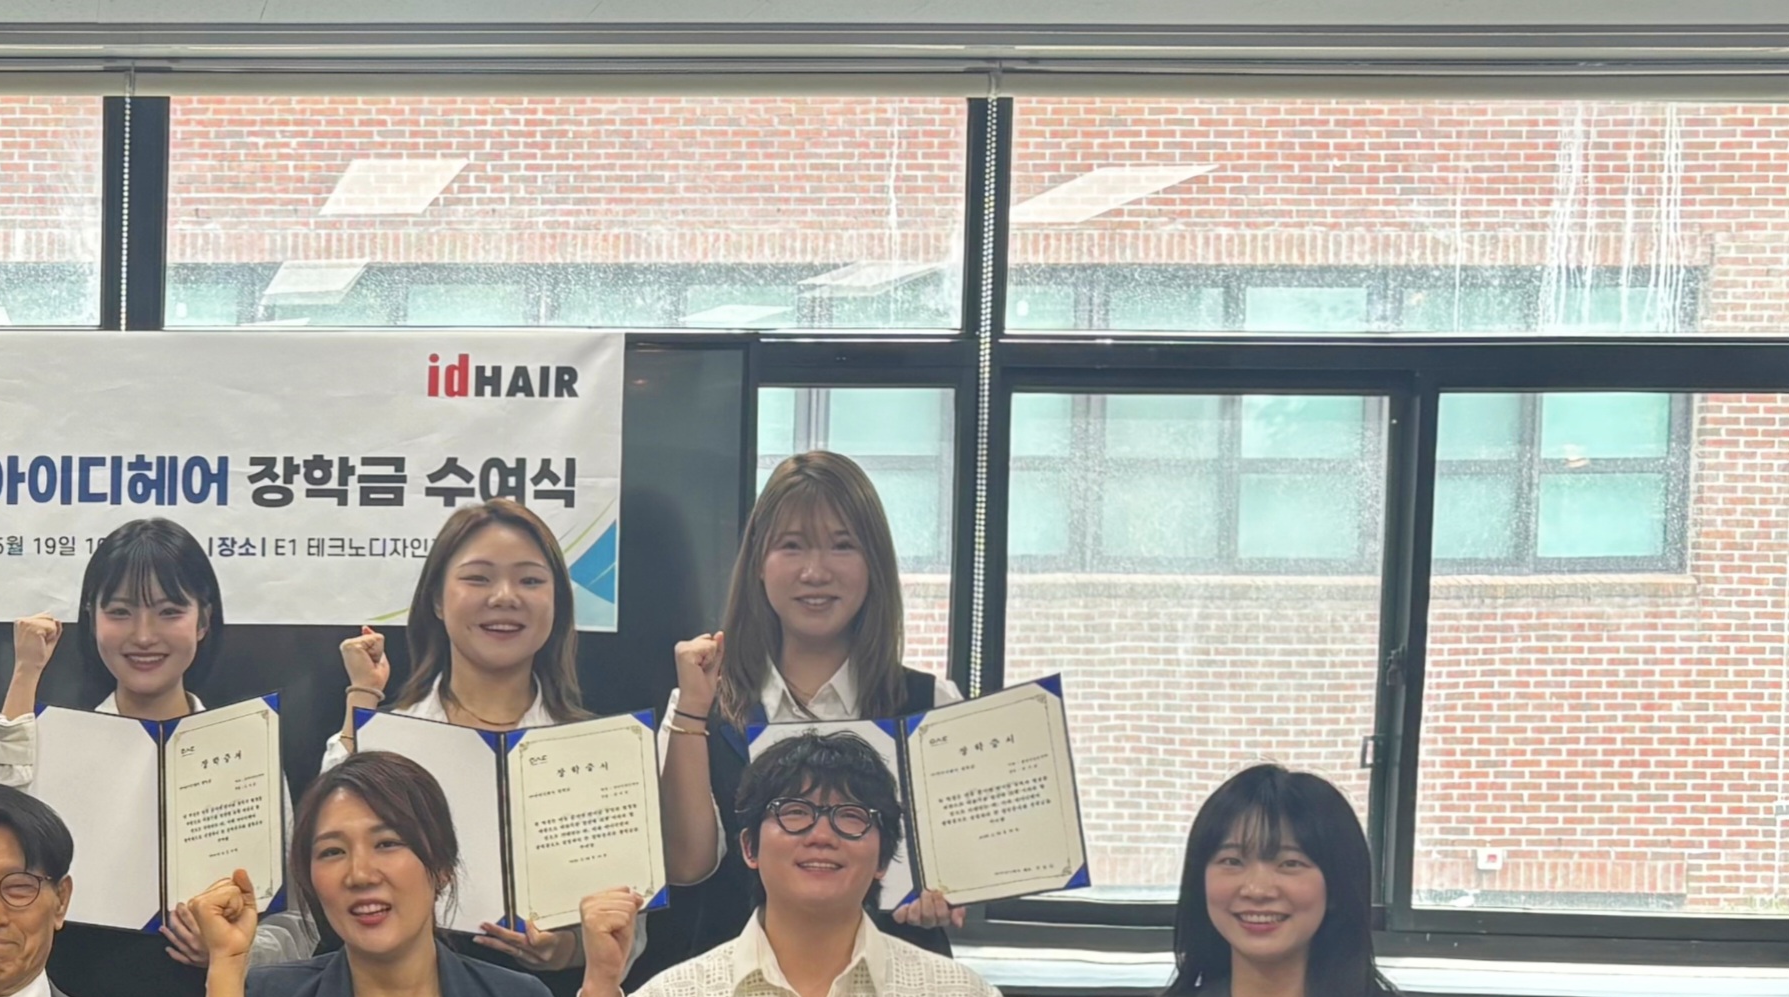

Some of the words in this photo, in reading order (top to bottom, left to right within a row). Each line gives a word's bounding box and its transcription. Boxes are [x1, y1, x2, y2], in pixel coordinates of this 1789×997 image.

[246, 454, 408, 508] 장학금
[424, 456, 577, 509] 수여식
[33, 535, 76, 556] 19일
[274, 538, 297, 557] E1
[306, 537, 436, 559] 테크노디자인
